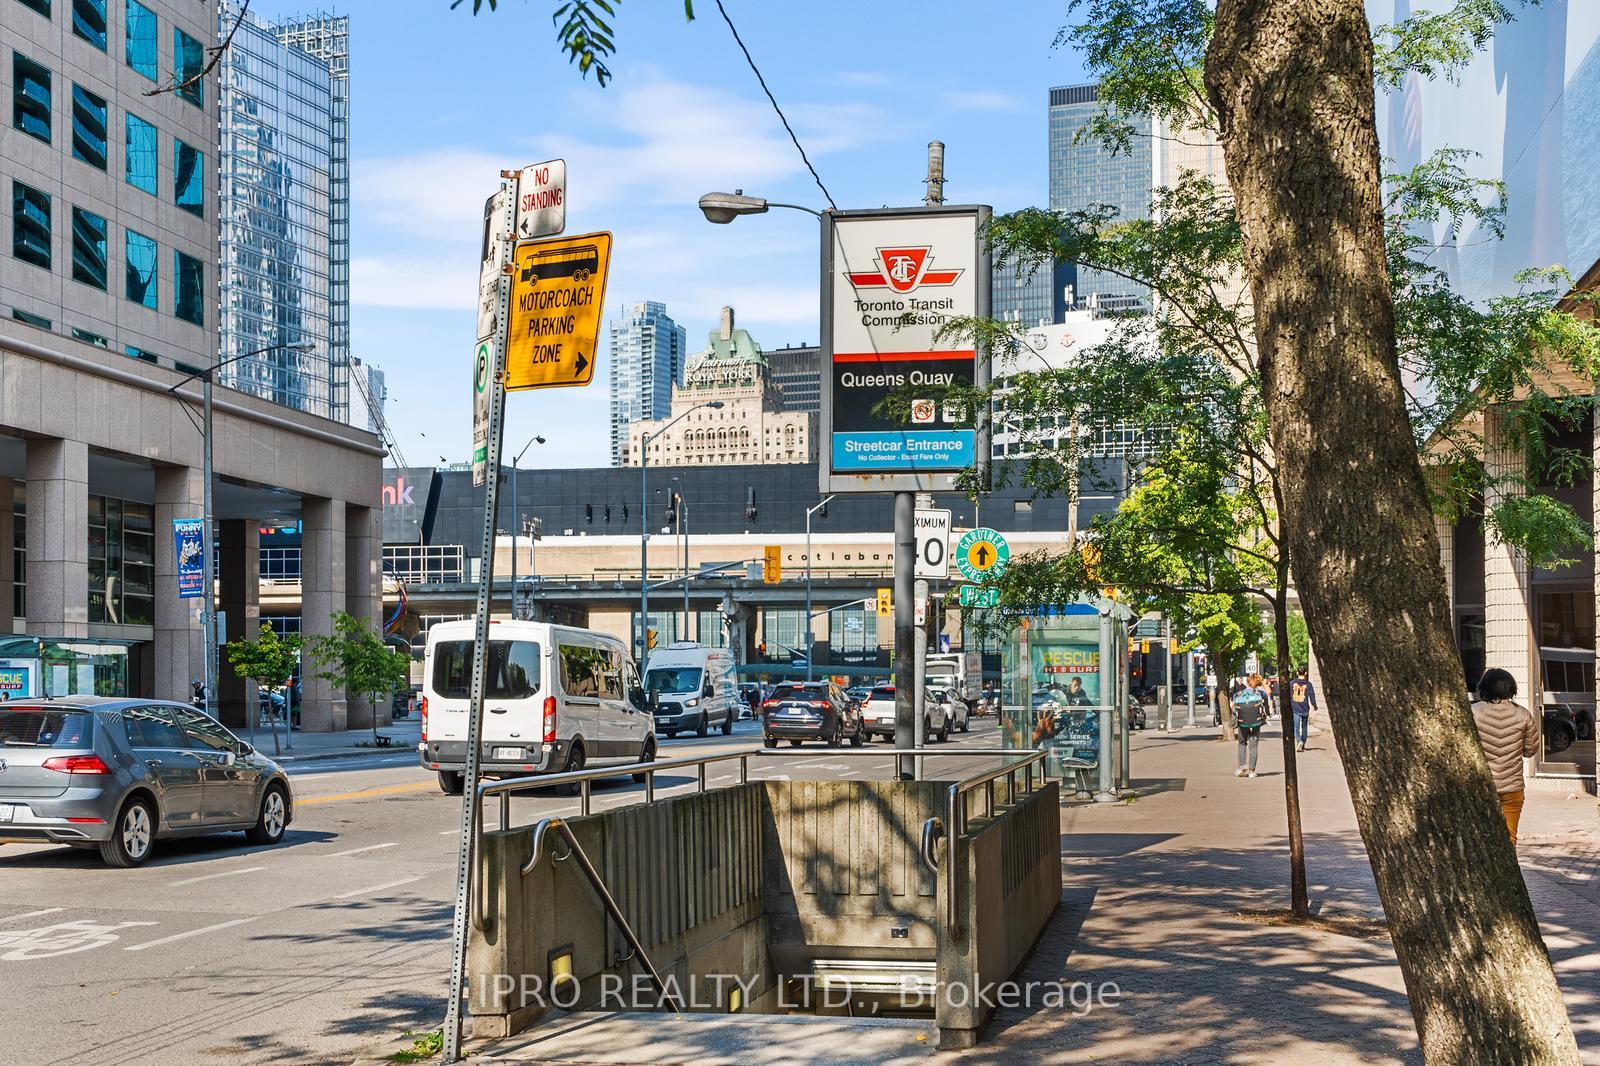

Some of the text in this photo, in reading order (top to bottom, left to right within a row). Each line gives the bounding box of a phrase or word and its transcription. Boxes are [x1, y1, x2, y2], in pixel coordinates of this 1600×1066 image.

[534, 167, 549, 187] NO
[522, 188, 562, 213] STANDING
[519, 286, 594, 313] MOTORCOACH
[854, 298, 954, 312] Toronto Transit
[528, 315, 576, 338] PARKING
[862, 314, 946, 327] Commission
[532, 343, 563, 365] ZONE
[841, 370, 954, 388] Queens Quay
[845, 438, 963, 452] Streetcar Entrance
[935, 452, 950, 461] Only
[381, 477, 415, 505] nk
[176, 524, 200, 532] FUNNY
[914, 518, 946, 528] XIMUM
[960, 529, 1005, 549] GARDINER
[1043, 652, 1100, 665] RESCUE
